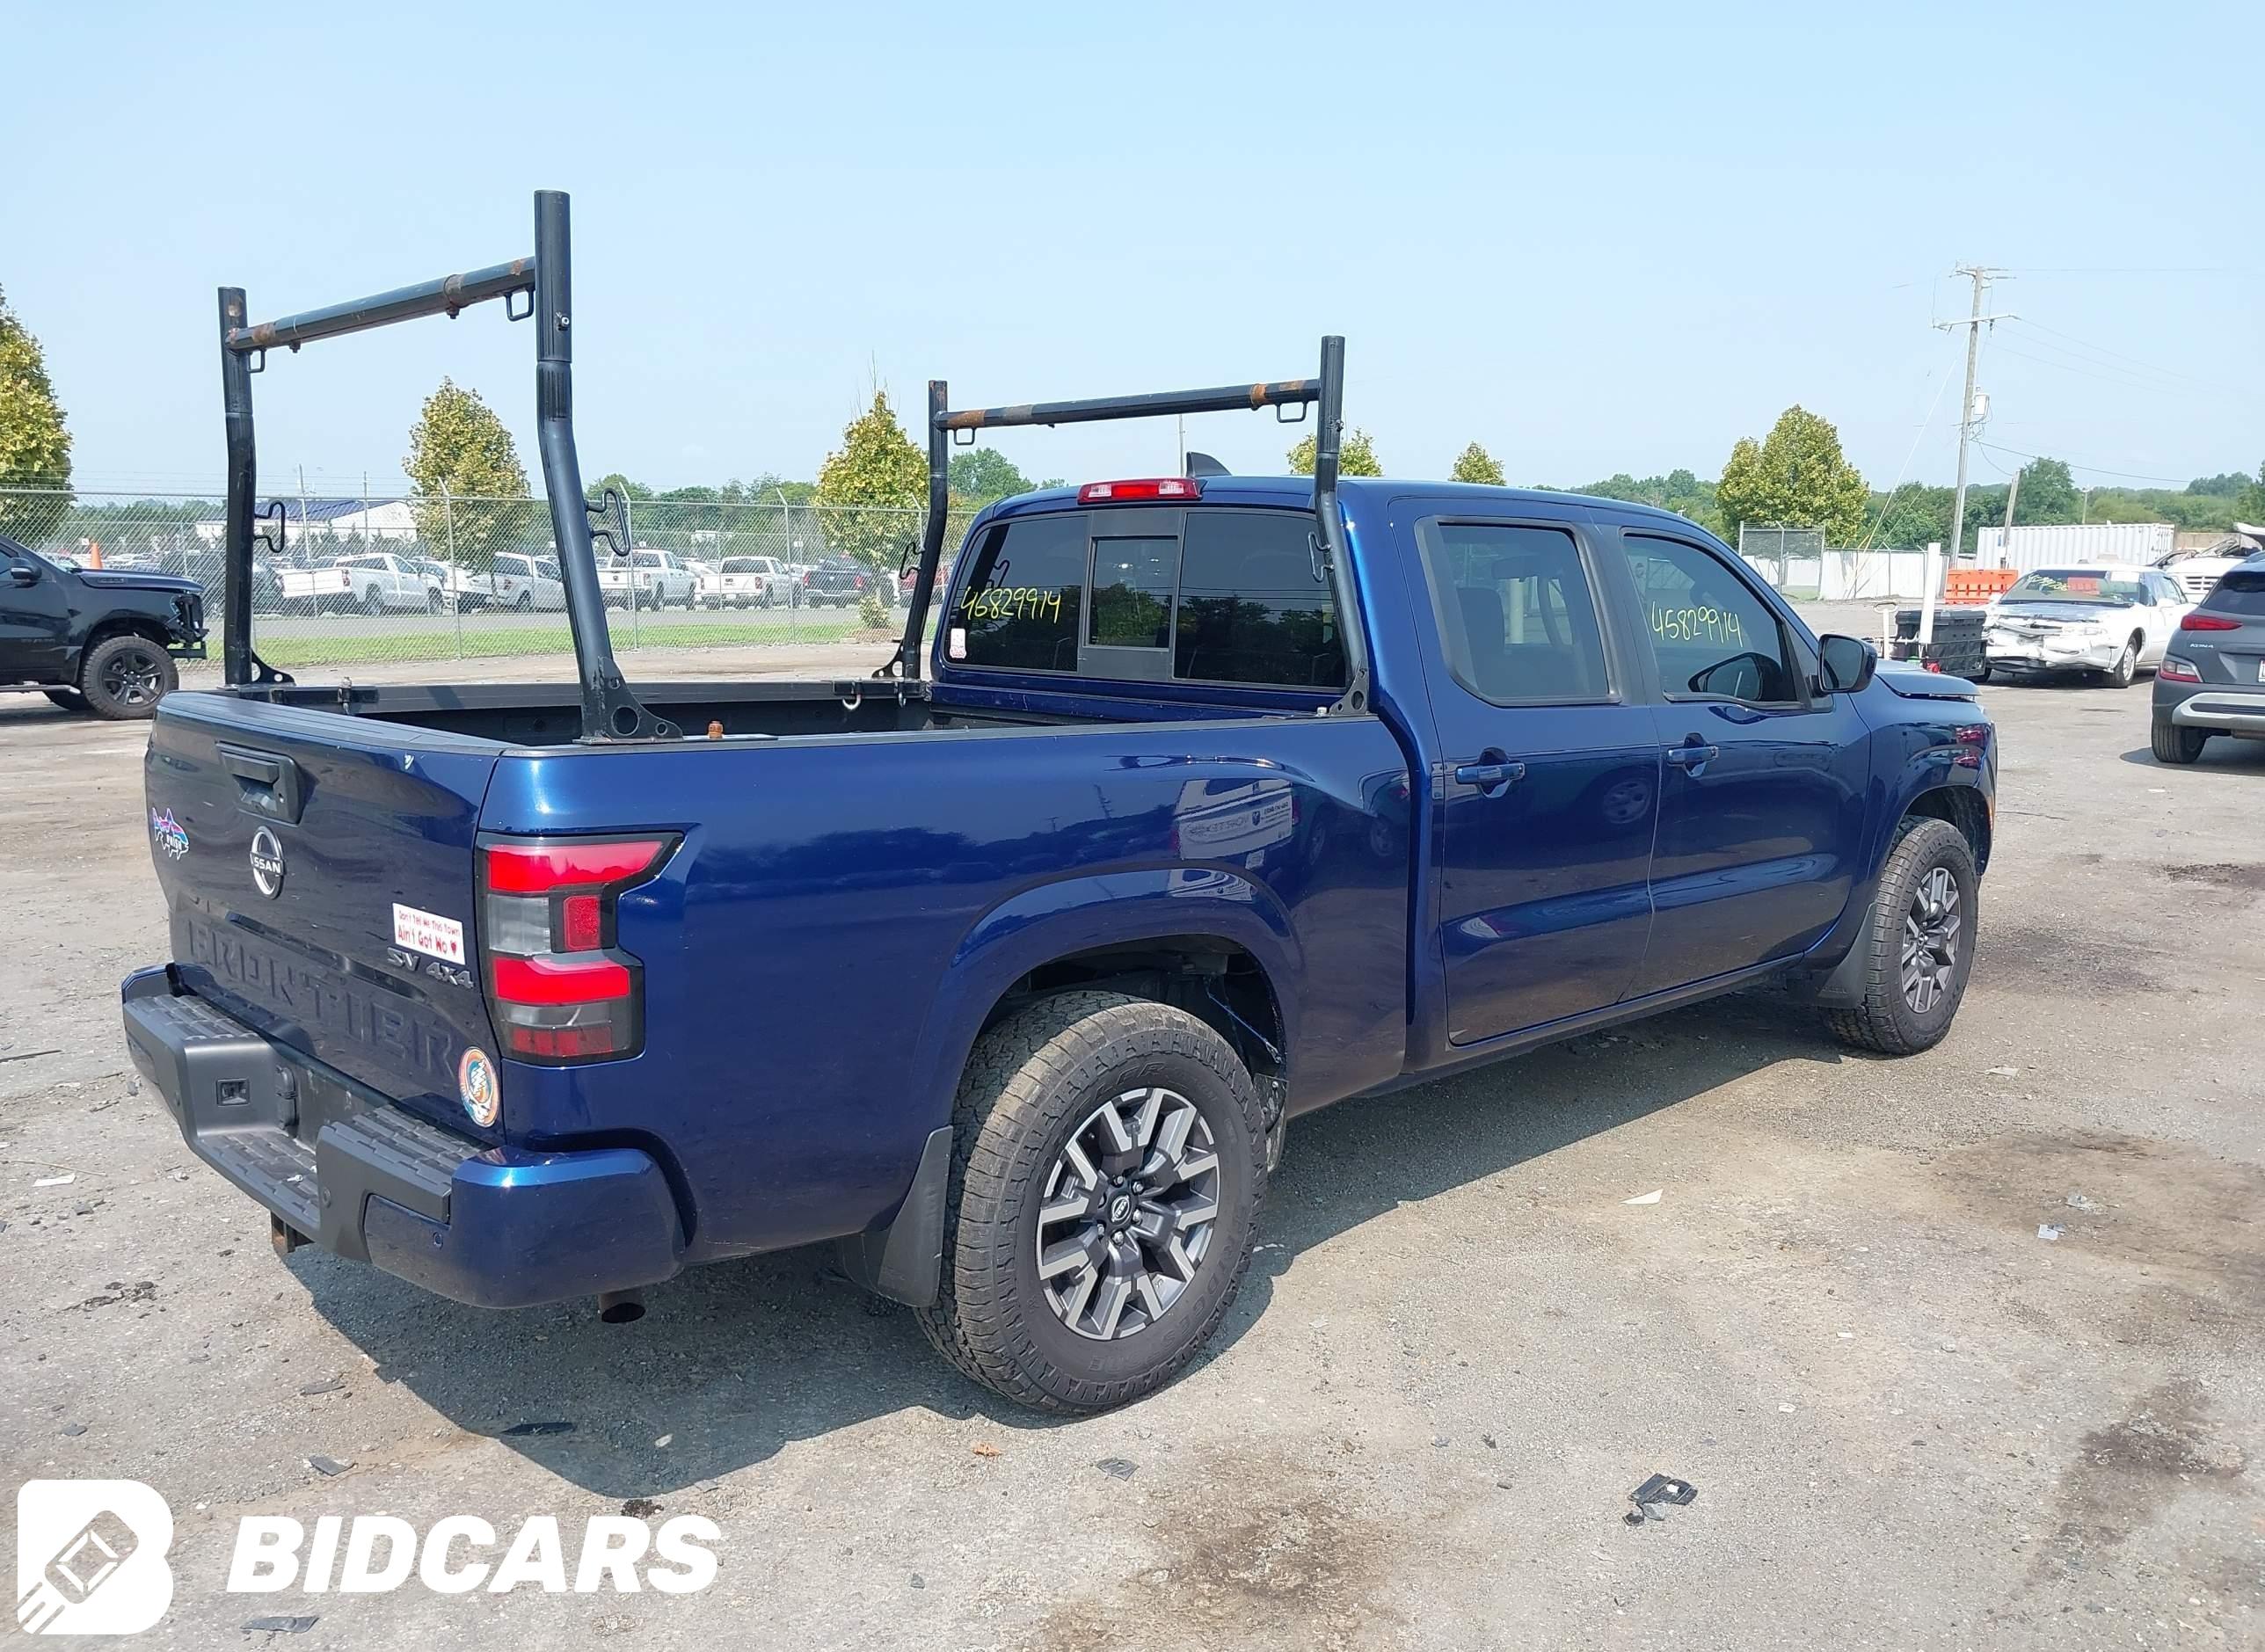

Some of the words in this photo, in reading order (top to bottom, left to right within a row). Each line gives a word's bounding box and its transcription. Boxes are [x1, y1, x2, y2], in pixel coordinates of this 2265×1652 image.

[1651, 600, 1744, 648] 45829914
[251, 854, 281, 874] SSAN
[398, 924, 415, 945] Ain't
[418, 930, 433, 950] Got
[432, 921, 443, 931] This
[444, 923, 461, 937] Town
[388, 947, 419, 971] SV
[188, 920, 456, 1082] FRONTIER
